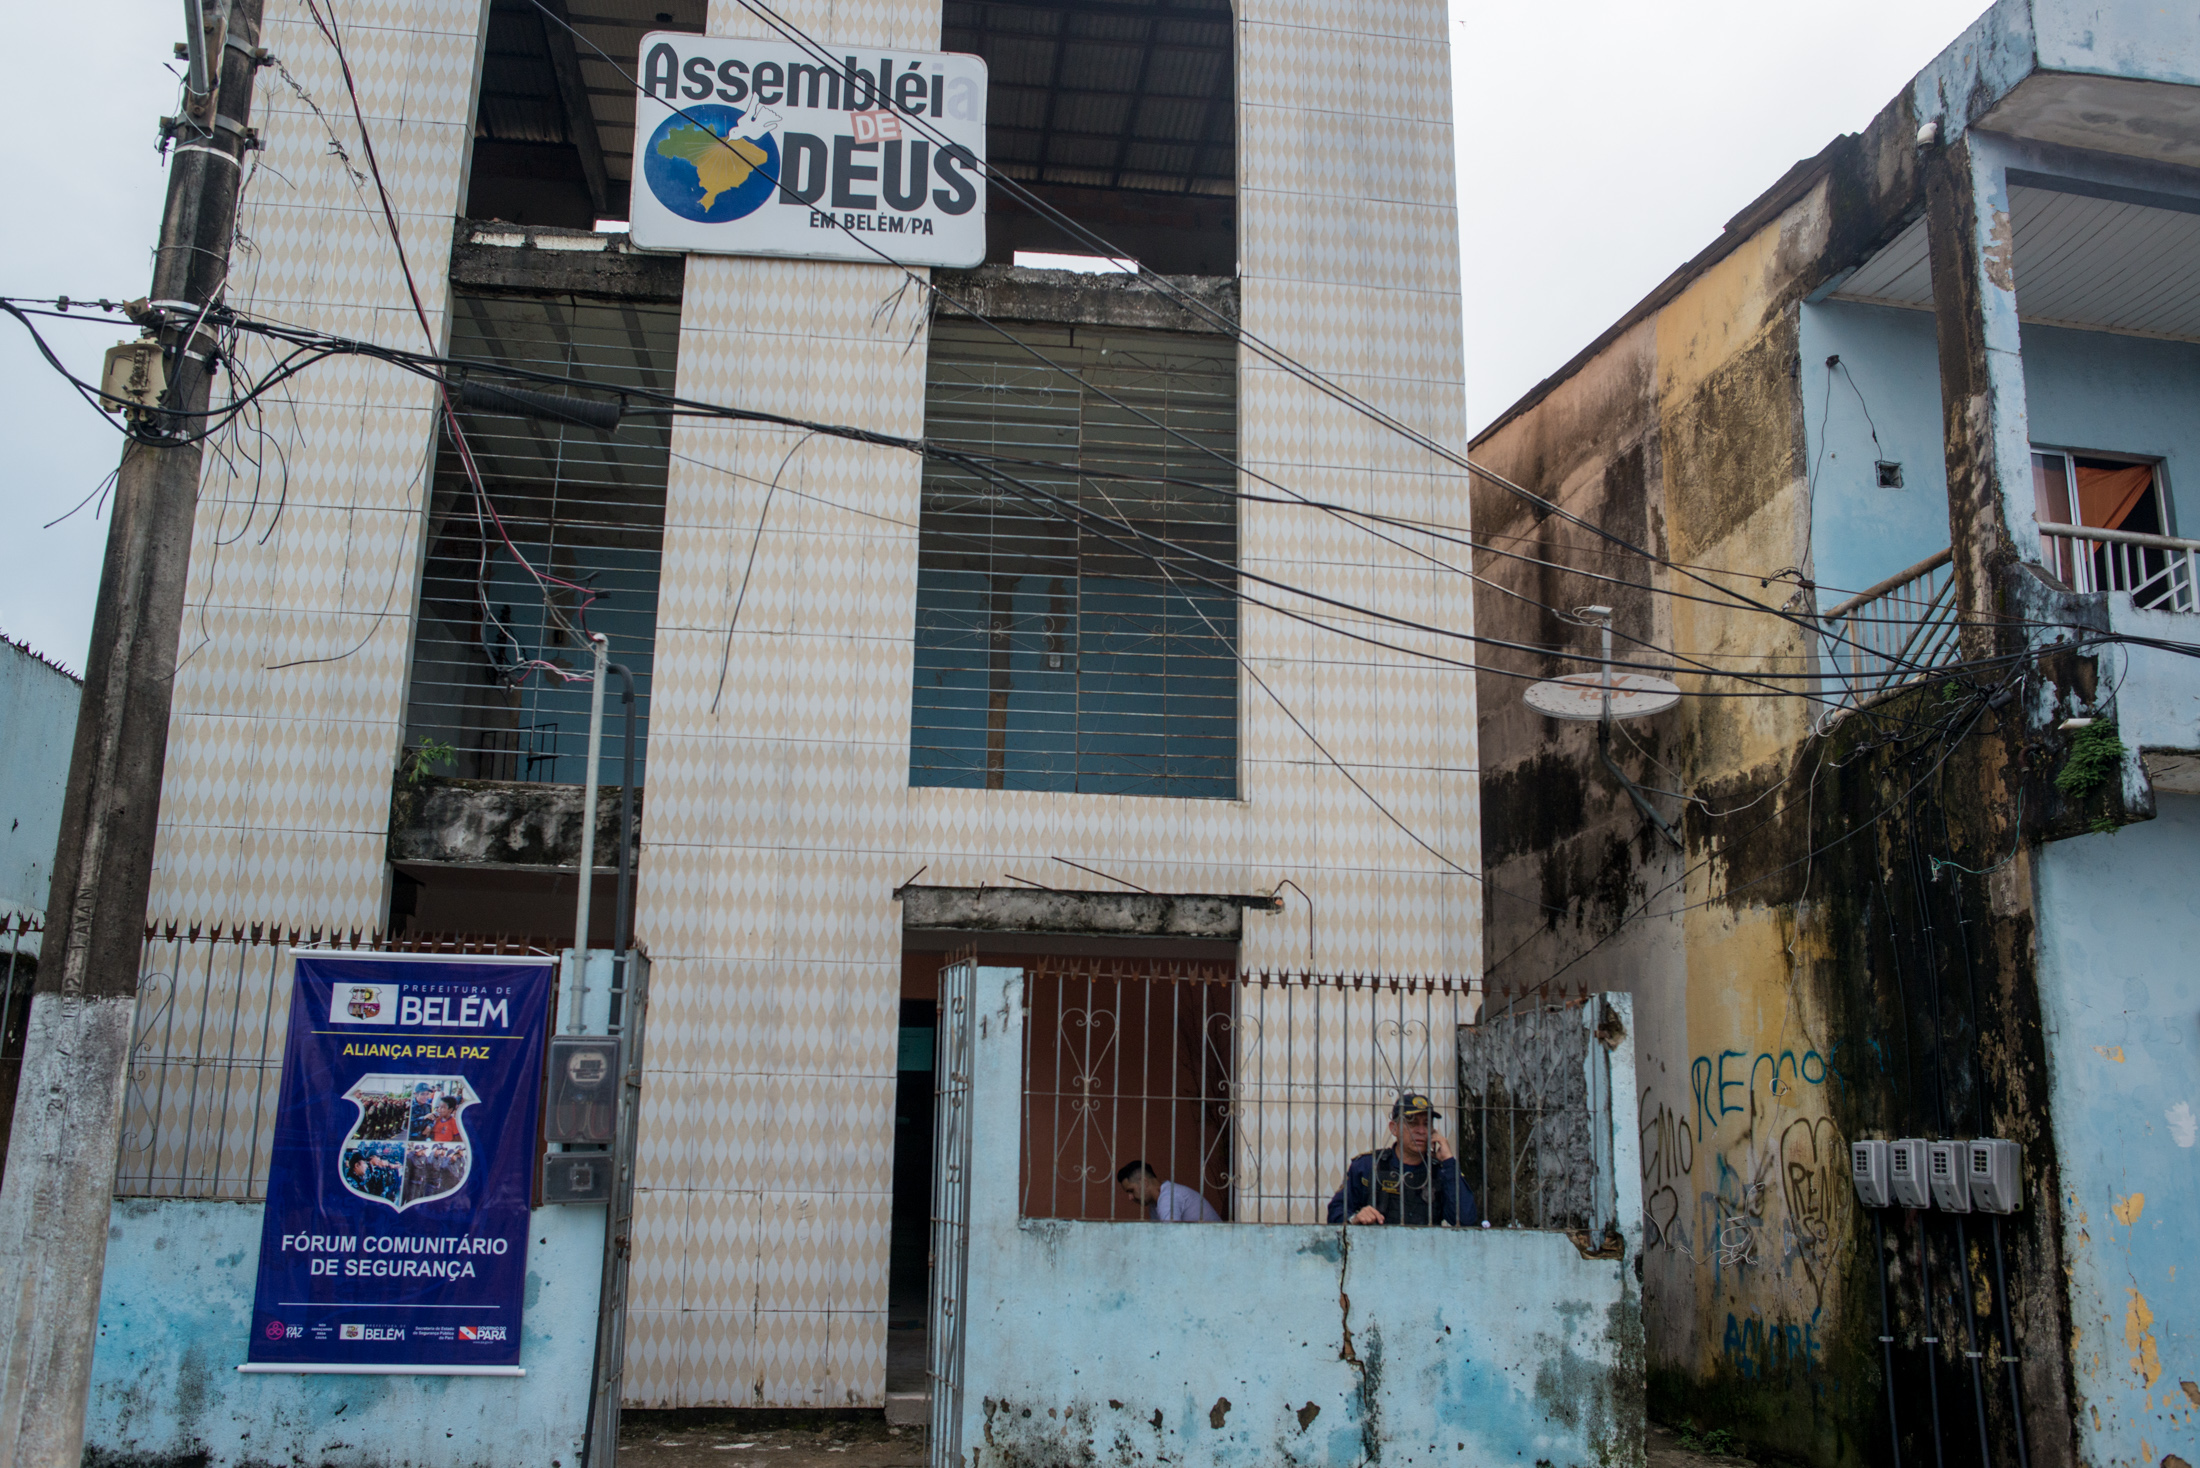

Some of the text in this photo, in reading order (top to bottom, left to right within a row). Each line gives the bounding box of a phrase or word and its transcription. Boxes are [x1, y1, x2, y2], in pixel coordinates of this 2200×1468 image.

[644, 42, 979, 121] Assembléia
[855, 114, 899, 143] DE
[778, 131, 977, 215] DEUS
[809, 211, 934, 236] EM BELÉM/PA
[1560, 675, 1632, 691] SKY
[402, 984, 511, 995] PREFEITURA DE
[400, 994, 509, 1028] BELÉM
[343, 1043, 490, 1060] ALIANÇA PELA PAZ
[281, 1230, 508, 1255] FÓRUM COMUNITÁRIO
[310, 1259, 476, 1282] DE SEGURANÇA
[365, 1328, 405, 1341] BELÉM
